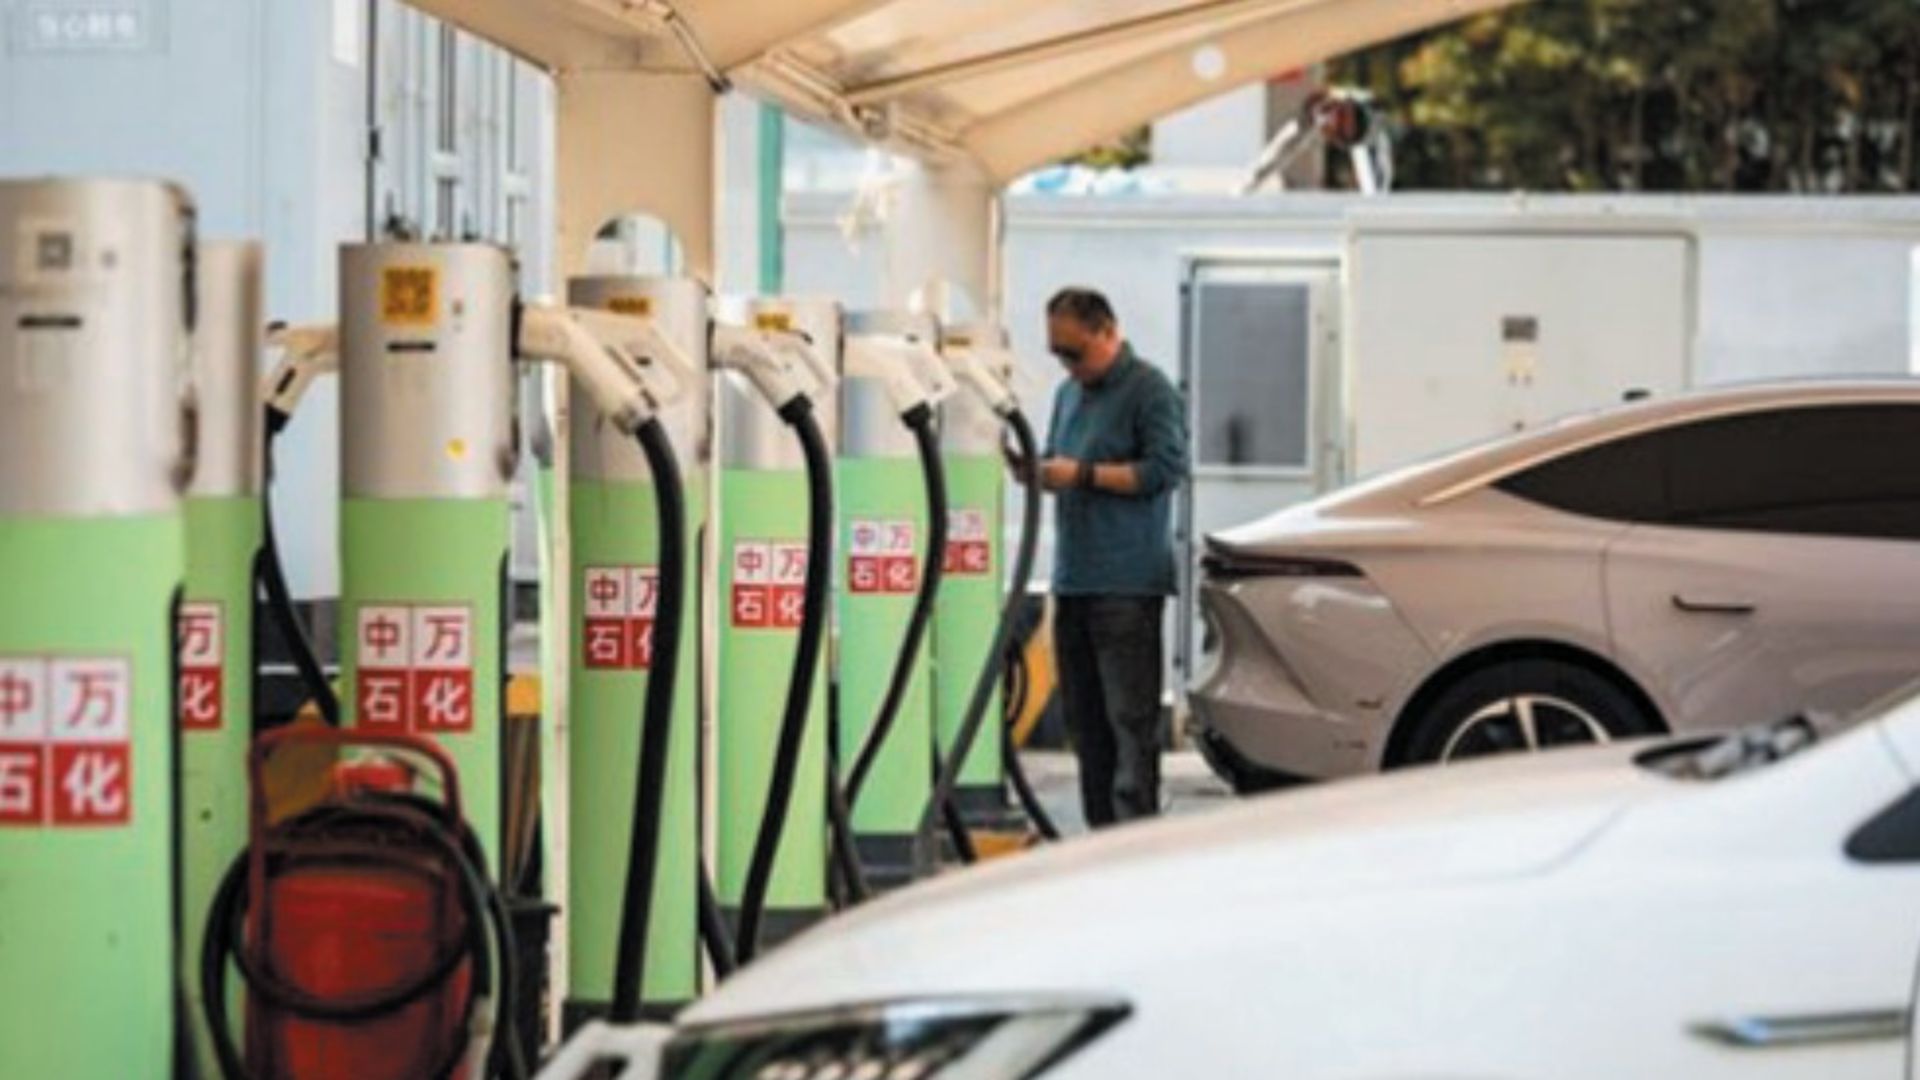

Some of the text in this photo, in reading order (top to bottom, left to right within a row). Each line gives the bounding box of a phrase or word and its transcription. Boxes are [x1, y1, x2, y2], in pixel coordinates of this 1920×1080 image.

[853, 561, 912, 588] 石化
[365, 614, 465, 659] 中万
[363, 678, 467, 723] 石化
